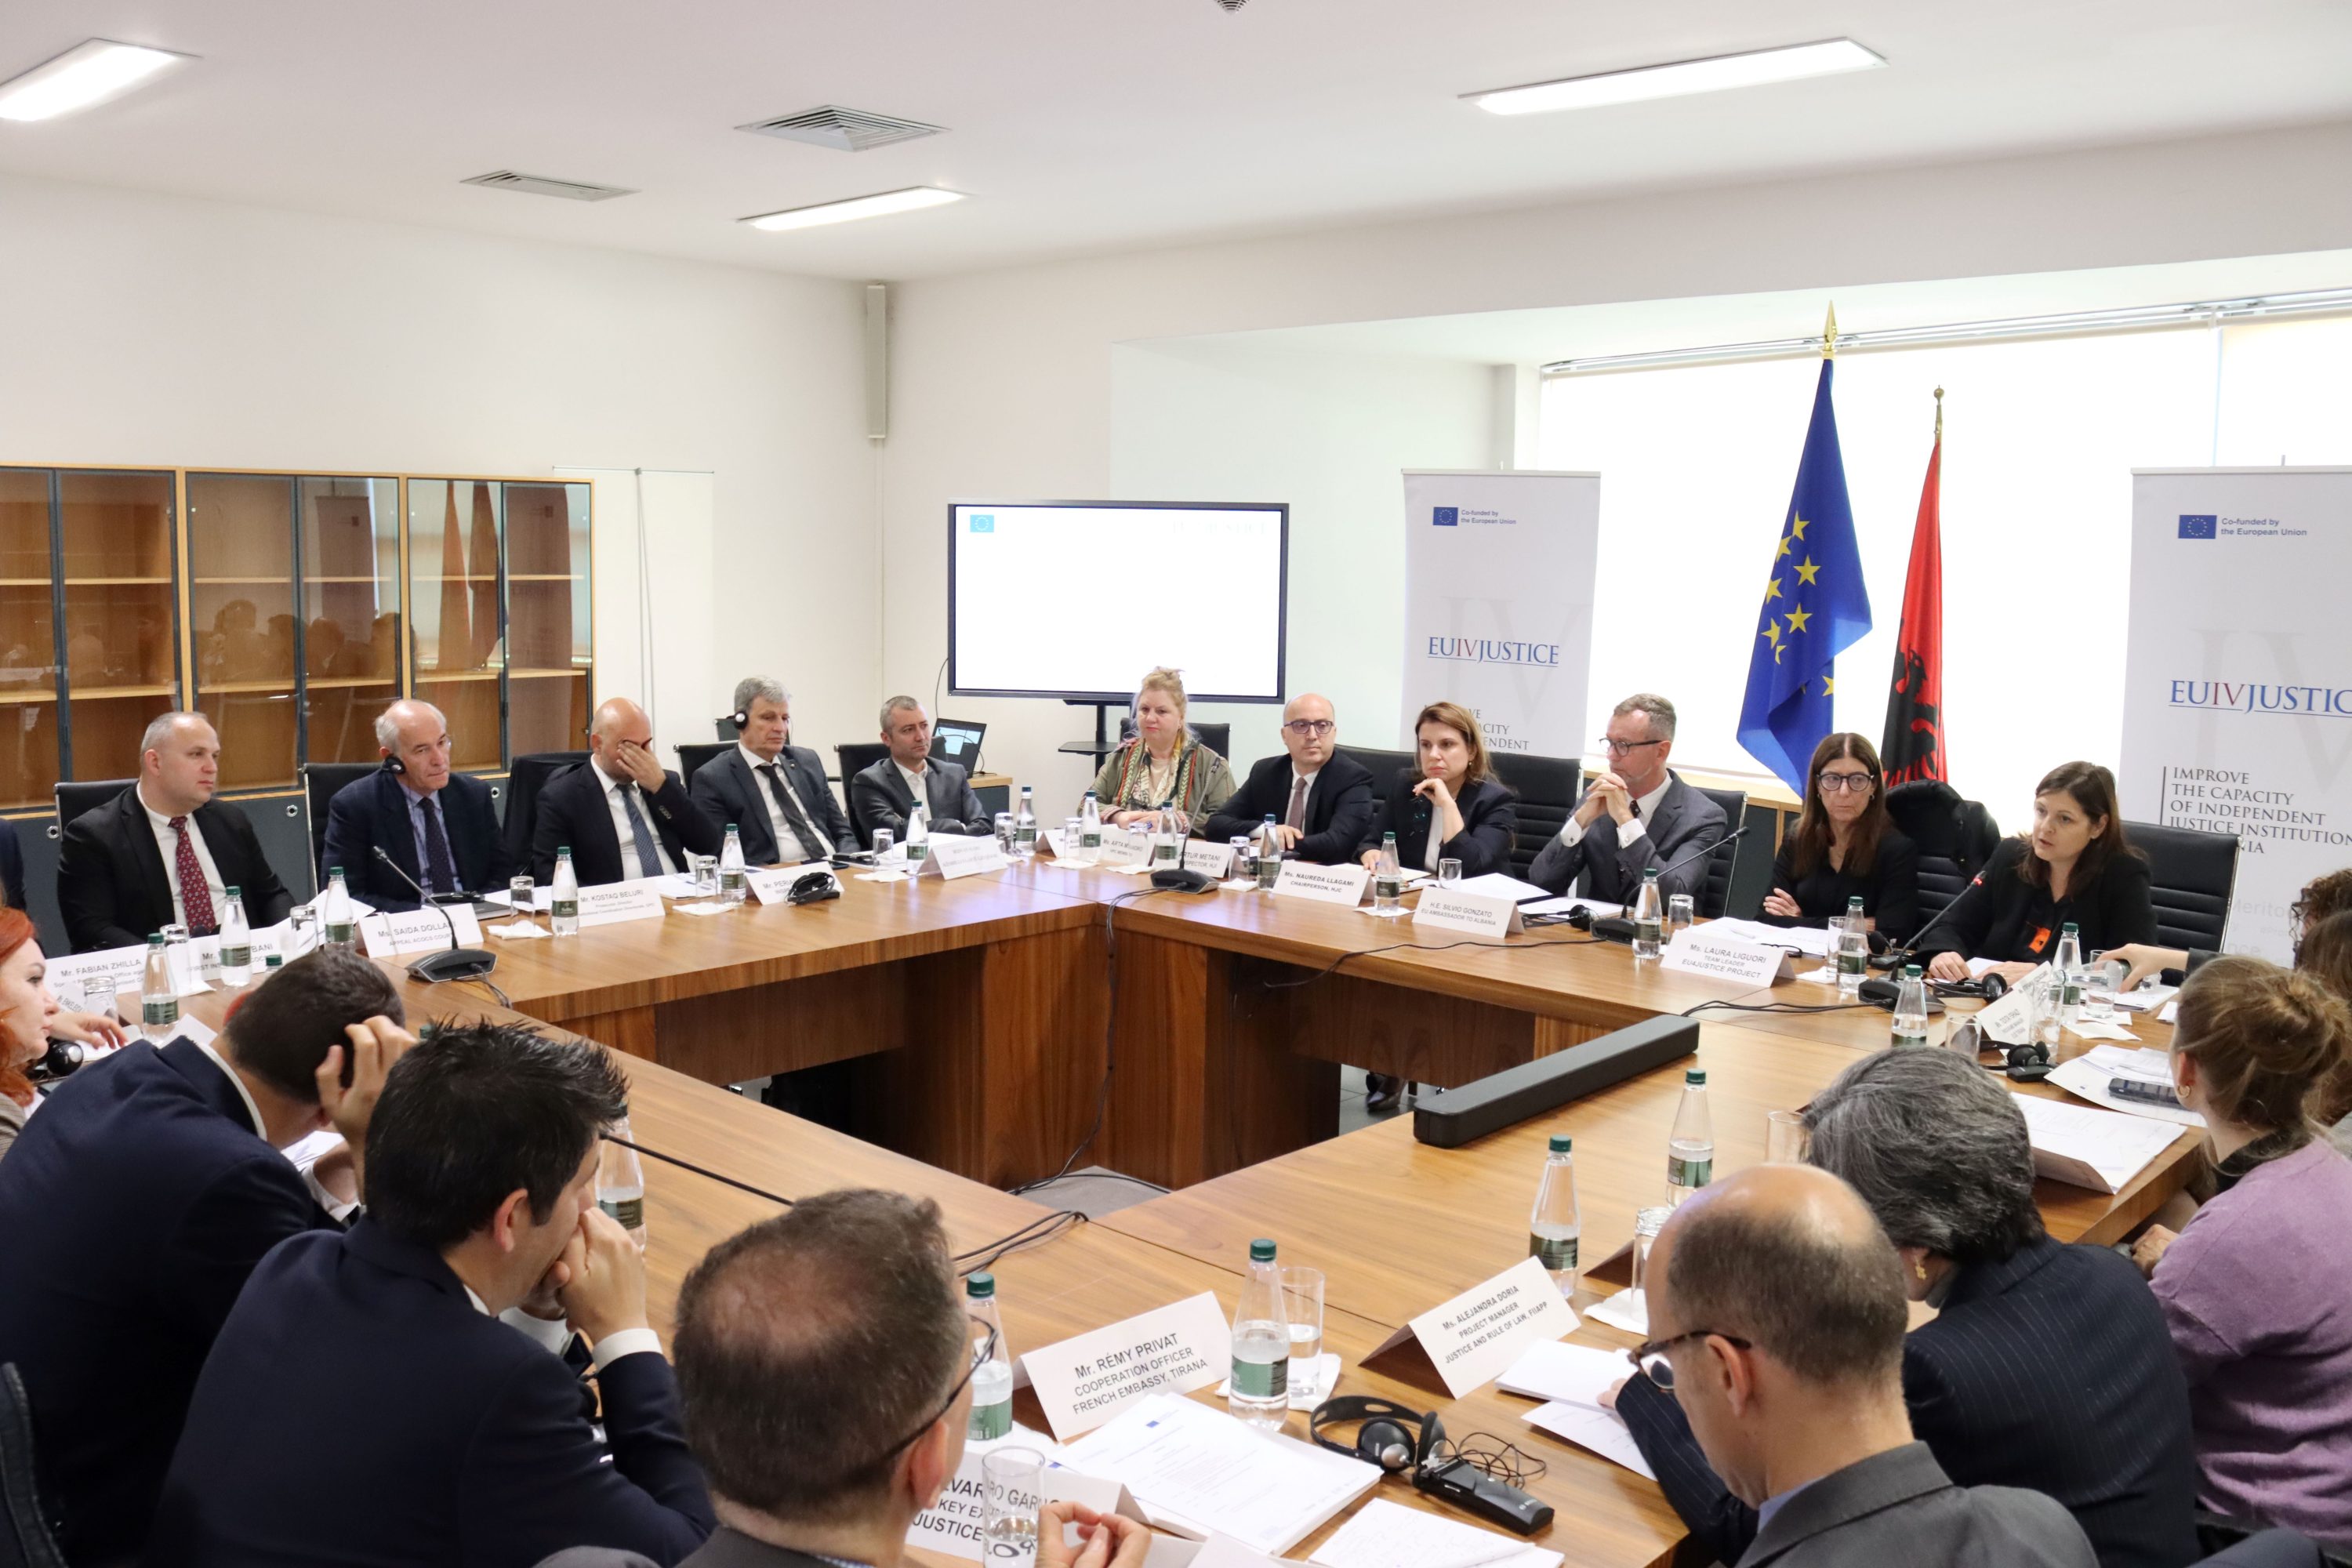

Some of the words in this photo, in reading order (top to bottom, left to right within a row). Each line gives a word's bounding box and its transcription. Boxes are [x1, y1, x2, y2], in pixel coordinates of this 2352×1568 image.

[2237, 528, 2278, 537] European
[1428, 637, 1559, 665] EUIVJUSTICE
[2169, 680, 2352, 714] EUIVJUSTIC
[2173, 767, 2250, 785] IMPROVE
[2172, 783, 2205, 797] THE
[2210, 786, 2295, 805] CAPACITY
[2170, 800, 2197, 812] OF
[2198, 802, 2326, 826] INDEPENDENT
[2171, 816, 2234, 833] JUSTICE
[1290, 880, 1330, 891] CHAIRPERSON,
[1296, 873, 1325, 882] NAUREDA
[1327, 878, 1355, 887] LLAGAMI
[592, 892, 619, 901] KOSTAQ
[1428, 909, 1465, 920] AMBASSADOR
[1443, 904, 1462, 913] SILVIO
[1463, 908, 1493, 918] GONZATO
[394, 926, 419, 935] SAIDA
[421, 920, 456, 931] DOLLAI
[251, 943, 273, 953] BANI
[389, 938, 412, 946] APPEAL
[1704, 946, 1731, 957] LAURA
[1733, 952, 1766, 964] LIGUORI
[1721, 958, 1745, 967] LEADER
[76, 964, 109, 975] FABIAN
[111, 959, 141, 970] ZHILLA
[1682, 958, 1726, 972] EU4JUSTICE
[1726, 967, 1761, 978] PROJECT
[1442, 1321, 1457, 1330] Ms.
[1456, 1297, 1498, 1323] ALEJANDRA
[1497, 1285, 1520, 1301] DORIA
[1458, 1317, 1489, 1339] PROJECT
[1488, 1301, 1520, 1323] MANAGER
[1445, 1343, 1474, 1364] JUSTICE
[1473, 1335, 1487, 1348] AND
[1486, 1326, 1505, 1341] RULE
[1504, 1320, 1513, 1330] OF
[1512, 1312, 1530, 1326] LAW,
[1528, 1301, 1548, 1317] FIIAPP
[1074, 1365, 1096, 1379] Mr.
[1096, 1349, 1133, 1372] RÉMY
[1134, 1333, 1179, 1358] PRIVAT
[1074, 1363, 1150, 1397] COOPERATION
[1150, 1347, 1194, 1370] OFFICER
[1072, 1391, 1117, 1414] FRENCH
[1118, 1374, 1171, 1399] EMBASSY,
[1169, 1358, 1208, 1380] TIRANA
[938, 1498, 967, 1515] KEY
